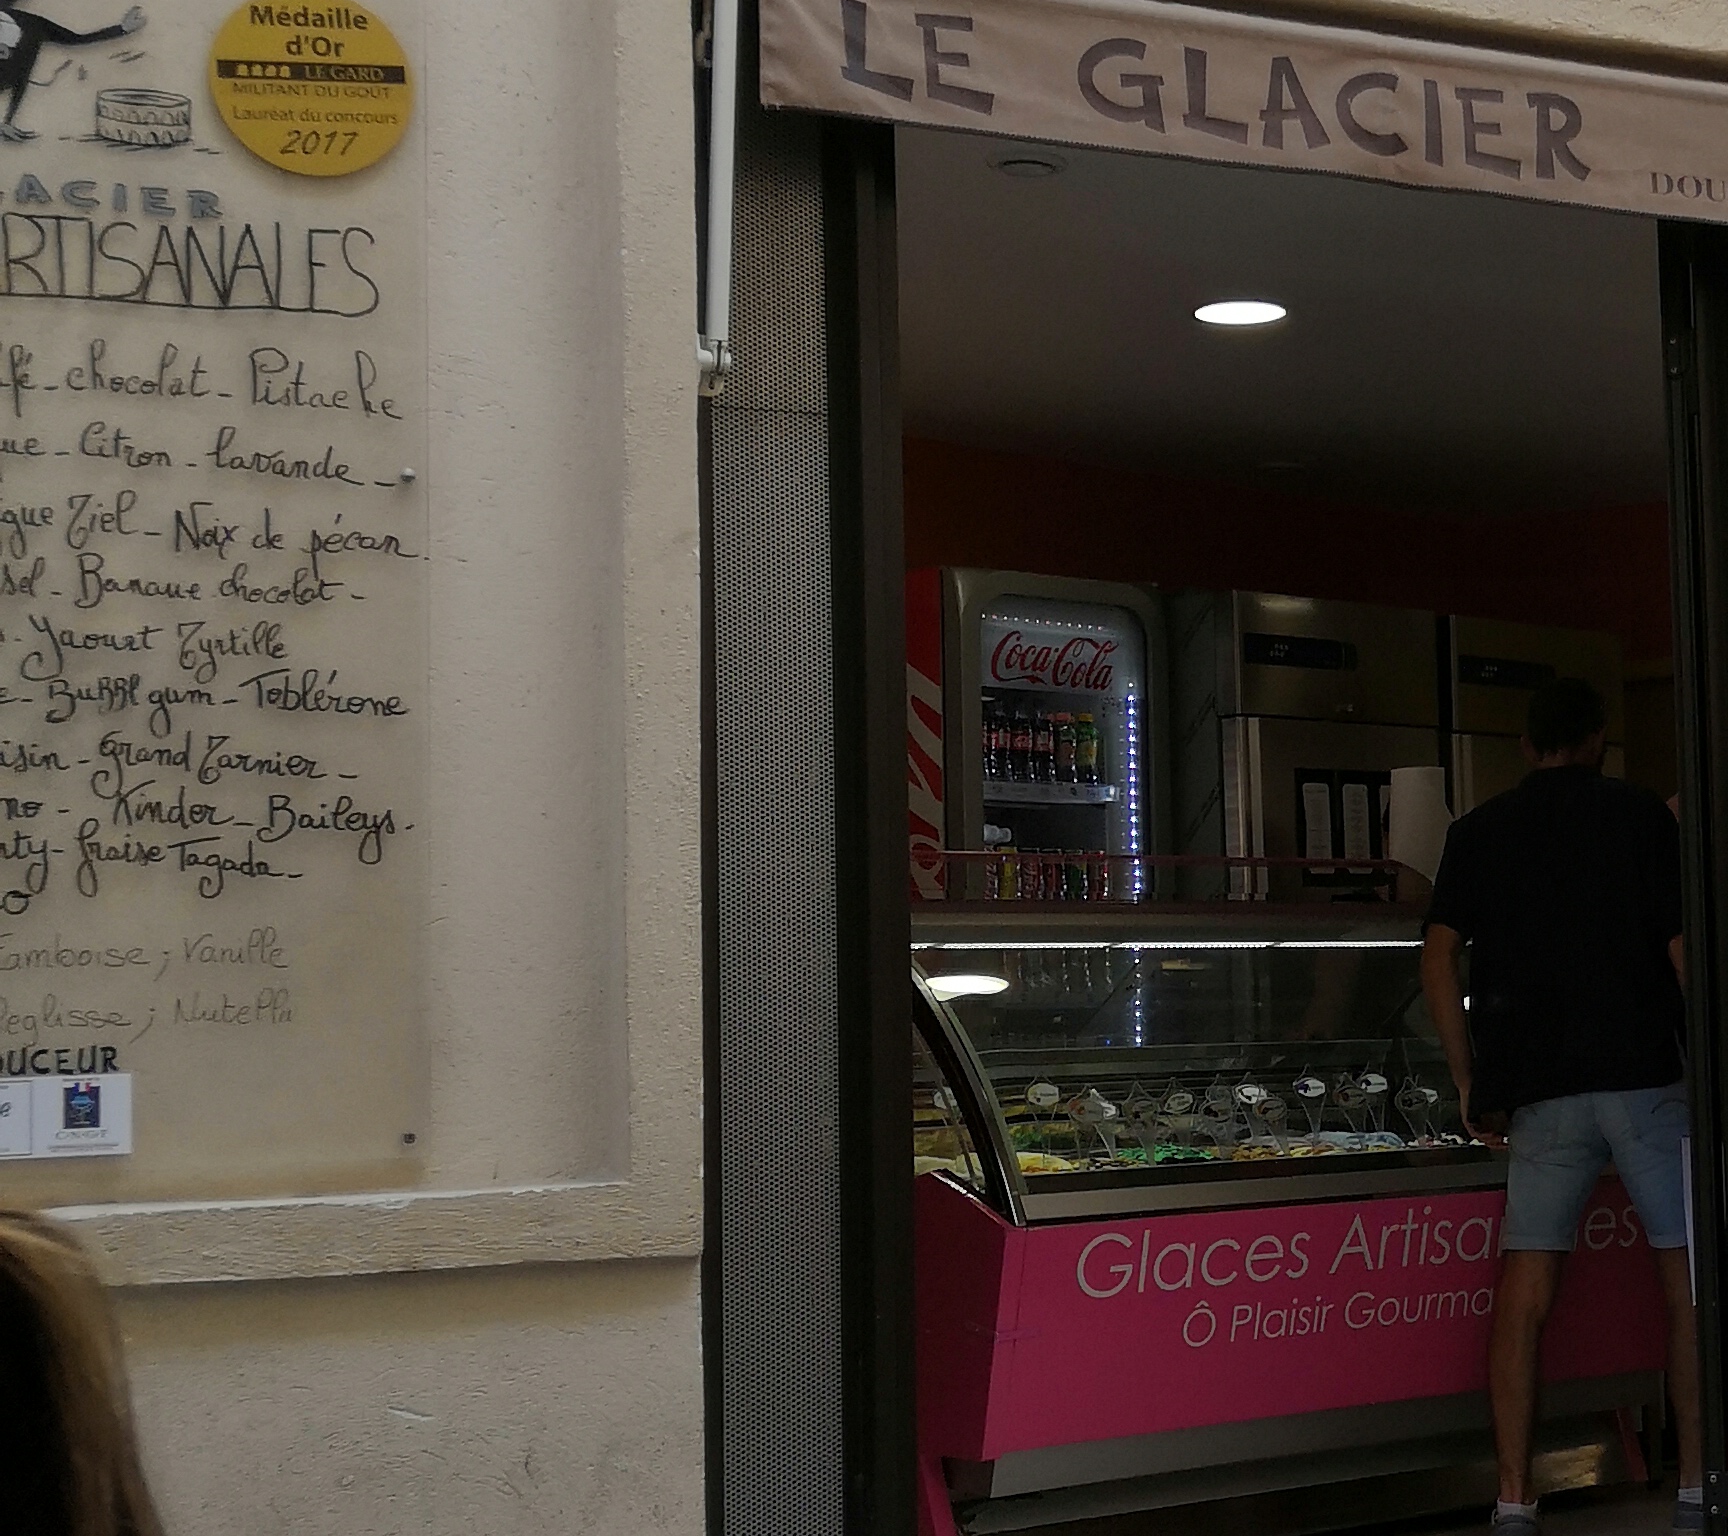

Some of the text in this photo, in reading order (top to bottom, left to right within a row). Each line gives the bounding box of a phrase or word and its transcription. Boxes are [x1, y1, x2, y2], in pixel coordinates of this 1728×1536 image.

[249, 5, 369, 31] Médaille
[285, 35, 345, 57] d'Or
[232, 82, 308, 96] MILITANT
[316, 85, 339, 97] DU
[304, 65, 385, 81] LE GARD
[300, 109, 321, 123] du
[326, 112, 399, 125] concours
[1077, 37, 1592, 183] GLACIER
[279, 129, 359, 156] 2017
[0, 173, 223, 218] ACIER
[0, 211, 379, 318] RTISANALES
[66, 338, 210, 398] chocolat
[249, 347, 403, 420] Pistache
[79, 421, 172, 468] Citron
[252, 507, 285, 552] de
[75, 553, 201, 609] Banane
[219, 563, 345, 607] chocolat
[21, 614, 164, 682] Yaourt
[991, 630, 1120, 691] Coca-Cola
[149, 686, 216, 738] gum
[113, 780, 235, 826] Kinder
[257, 795, 396, 865] Baileys
[183, 925, 290, 969] Vanille
[174, 987, 295, 1026] Nutella
[0, 1044, 120, 1075] UCEUR
[1075, 1204, 1640, 1299] Glaces Artisaes
[1181, 1286, 1493, 1348] Ô Plaisir Gourma
